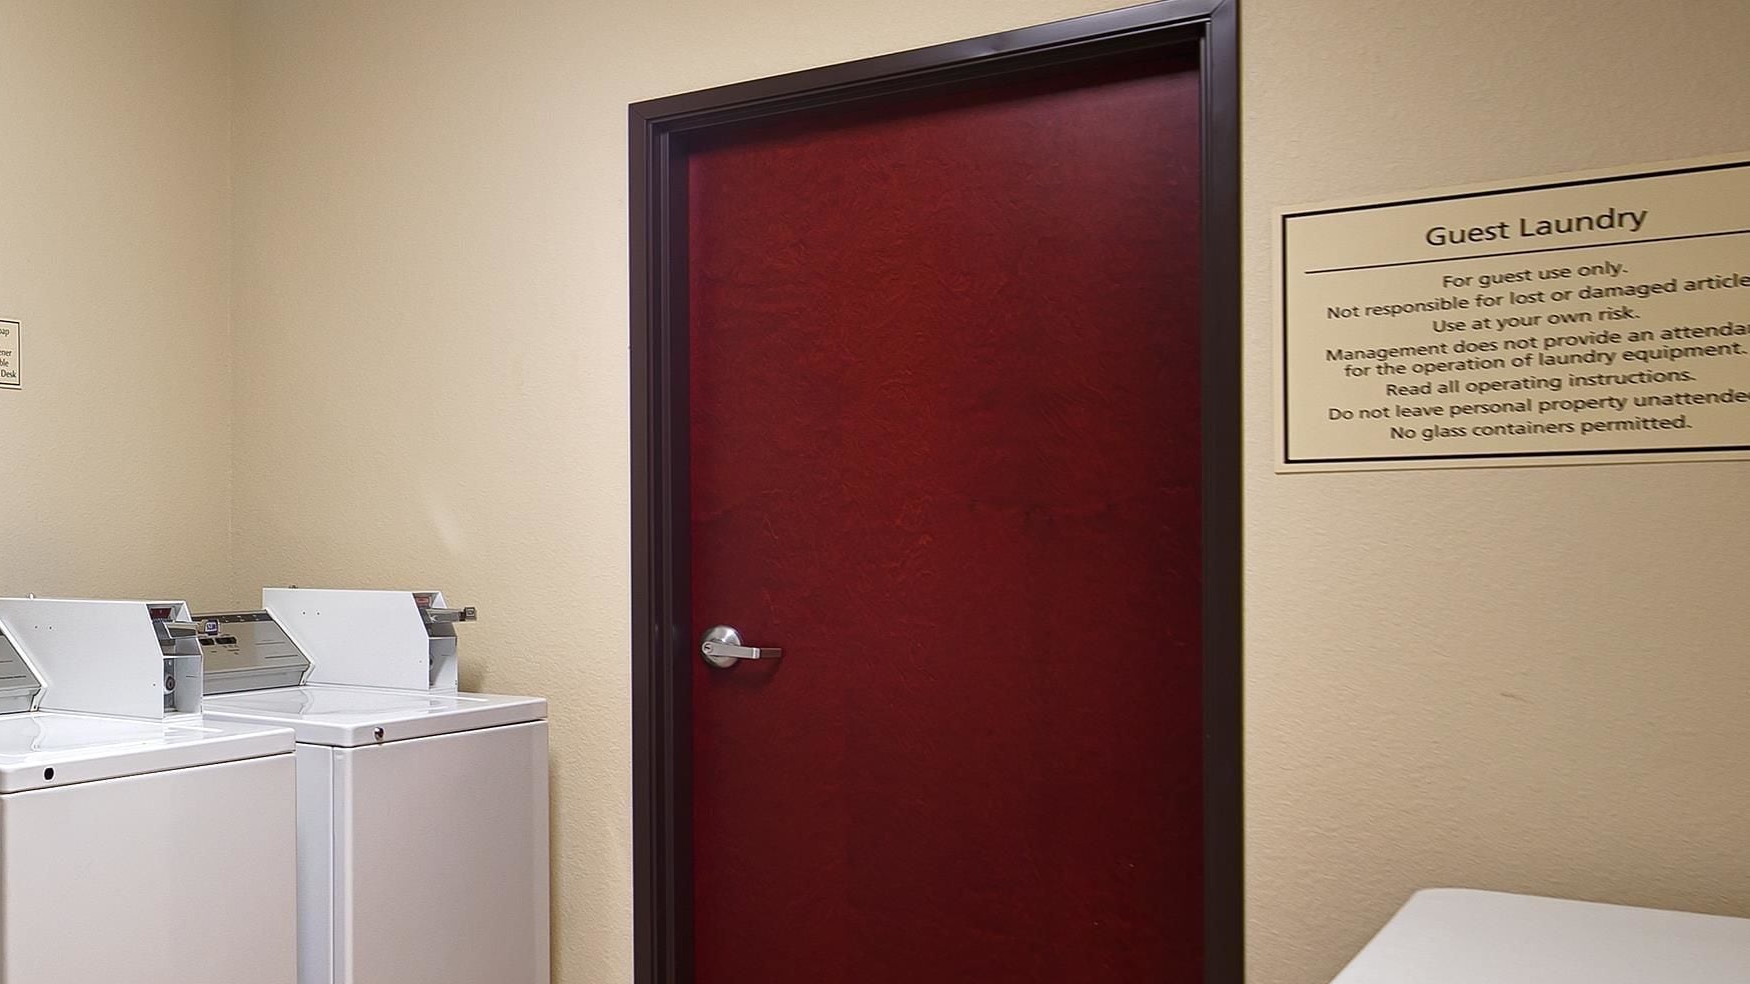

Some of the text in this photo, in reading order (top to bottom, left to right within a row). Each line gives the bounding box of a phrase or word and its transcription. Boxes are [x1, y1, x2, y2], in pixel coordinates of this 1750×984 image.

[1426, 208, 1648, 246] Guest Laundry
[1443, 261, 1628, 288] For guest use only.
[1327, 306, 1360, 319] Not
[1364, 295, 1469, 317] responsible
[1475, 293, 1505, 307] for
[1509, 288, 1545, 305] lost
[1550, 290, 1573, 302] or
[1578, 279, 1676, 299] damaged
[1433, 306, 1640, 333] Use at your own risk.
[1326, 342, 1448, 361] Management
[1453, 339, 1498, 354] does
[1504, 338, 1537, 350] not
[1543, 330, 1621, 350] provide
[1628, 329, 1654, 342] an
[1345, 342, 1747, 377] for the operation of laundry equipment.
[1, 370, 16, 378] Desk
[1386, 370, 1696, 396] Read all operating instructions.
[1329, 389, 1750, 421] Do not leave personal property unattende
[1390, 415, 1692, 442] No glass containers permitted.
